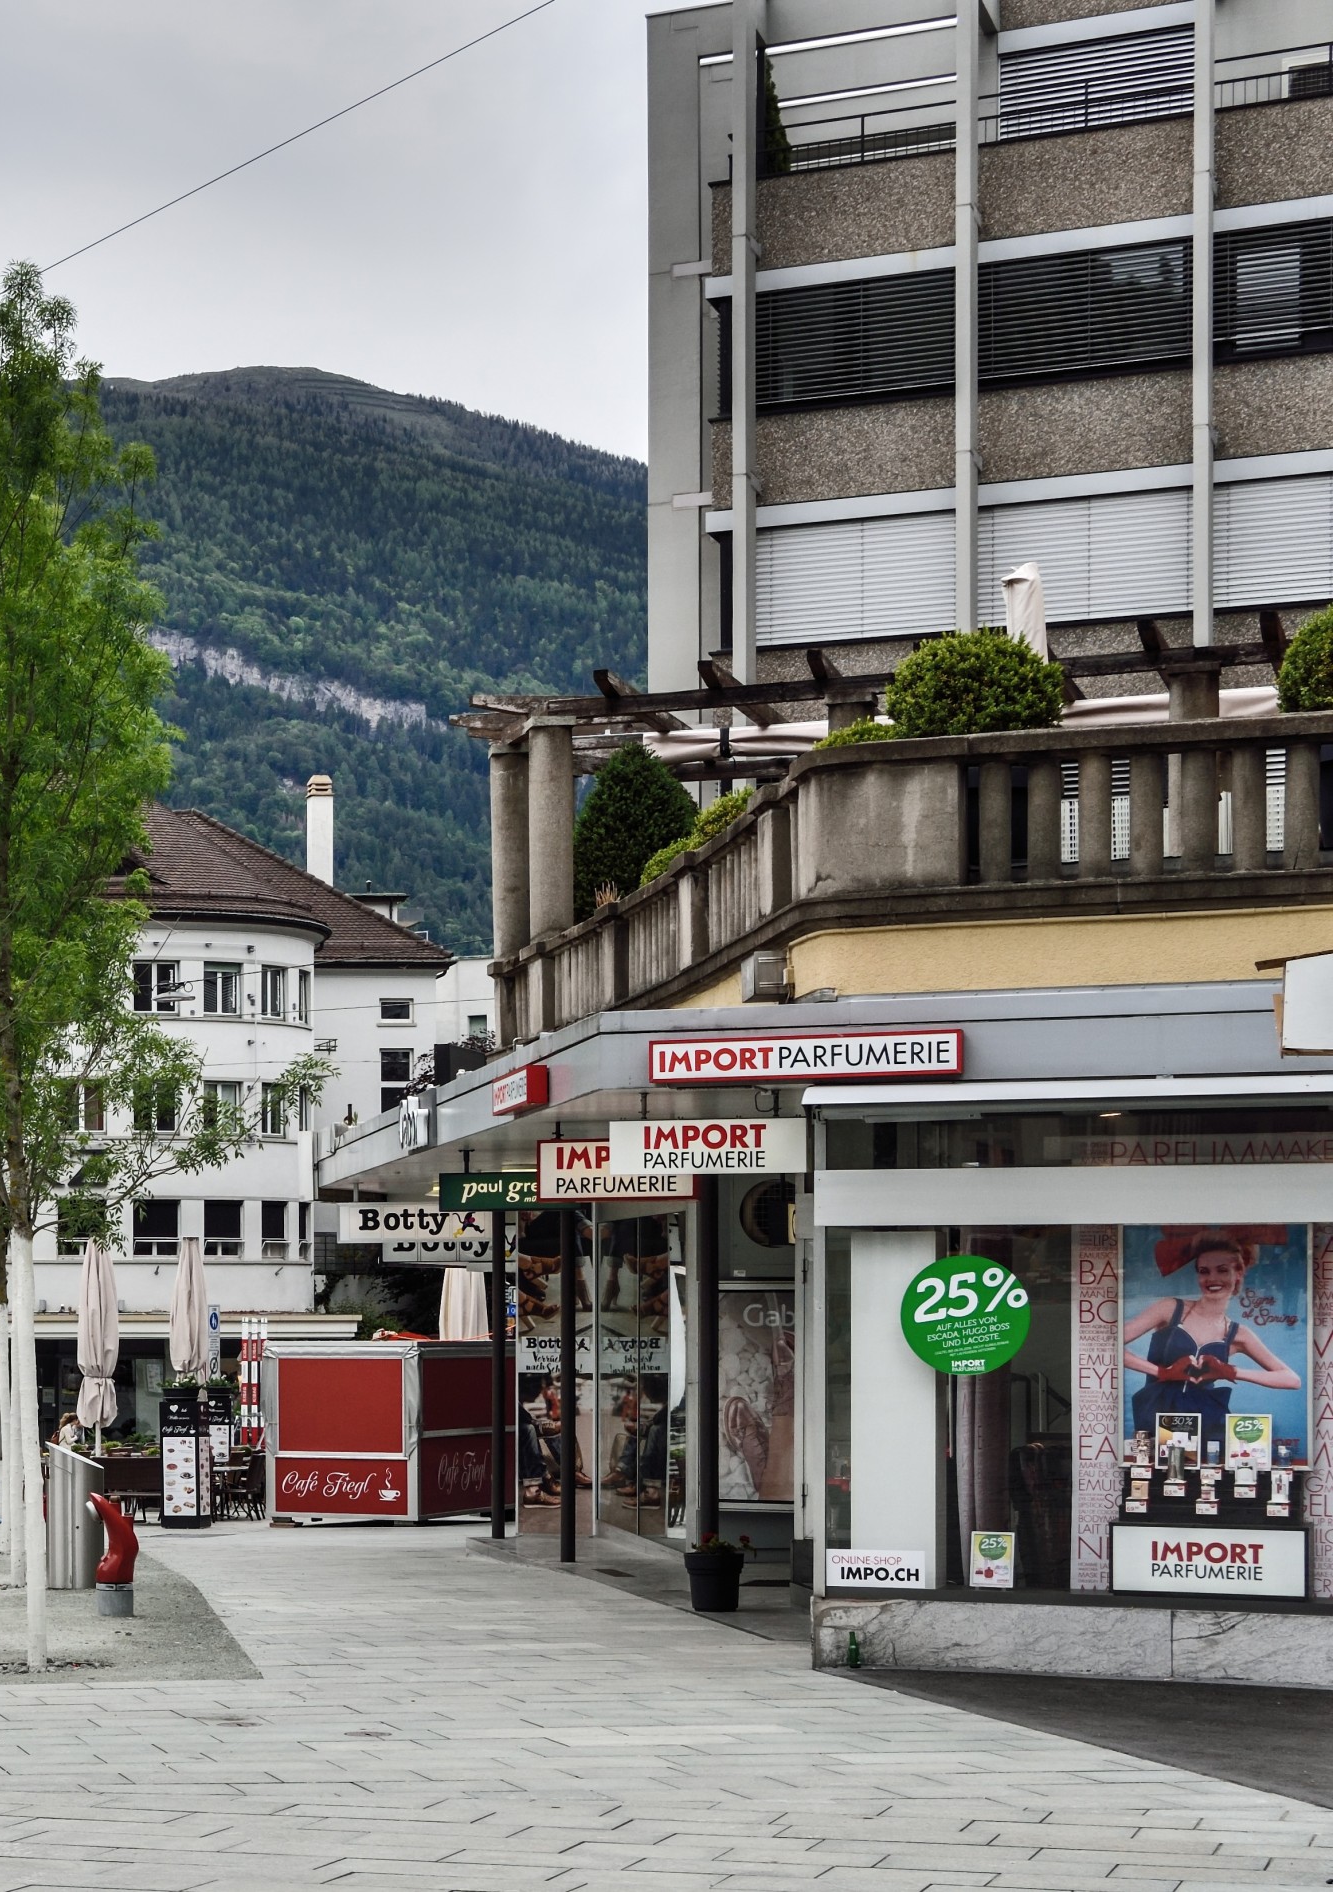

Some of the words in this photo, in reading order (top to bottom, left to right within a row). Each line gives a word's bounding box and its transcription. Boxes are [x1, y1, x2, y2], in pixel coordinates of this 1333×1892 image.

[644, 1124, 767, 1150] IMPORT
[644, 1151, 766, 1169] PARFUMERIE
[461, 1180, 503, 1203] paul
[557, 1176, 678, 1194] PARFUMERIE
[358, 1208, 450, 1235] Botty
[914, 1267, 1029, 1323] 25%
[743, 1304, 795, 1327] Gab
[936, 1321, 952, 1332] AUF
[953, 1318, 977, 1329] ALLES
[979, 1316, 998, 1325] VON
[962, 1326, 988, 1336] HUGO
[989, 1322, 1010, 1333] BOSS
[942, 1340, 961, 1348] UND
[951, 1359, 986, 1367] IMPORT
[1235, 1420, 1265, 1432] 25%
[281, 1471, 319, 1498] Café
[322, 1471, 377, 1500] Fiegl
[981, 1537, 1008, 1549] 25%
[1151, 1540, 1264, 1565] IMPORT
[840, 1566, 920, 1582] IMPO.CH
[1151, 1563, 1264, 1581] PARFUMERIE
